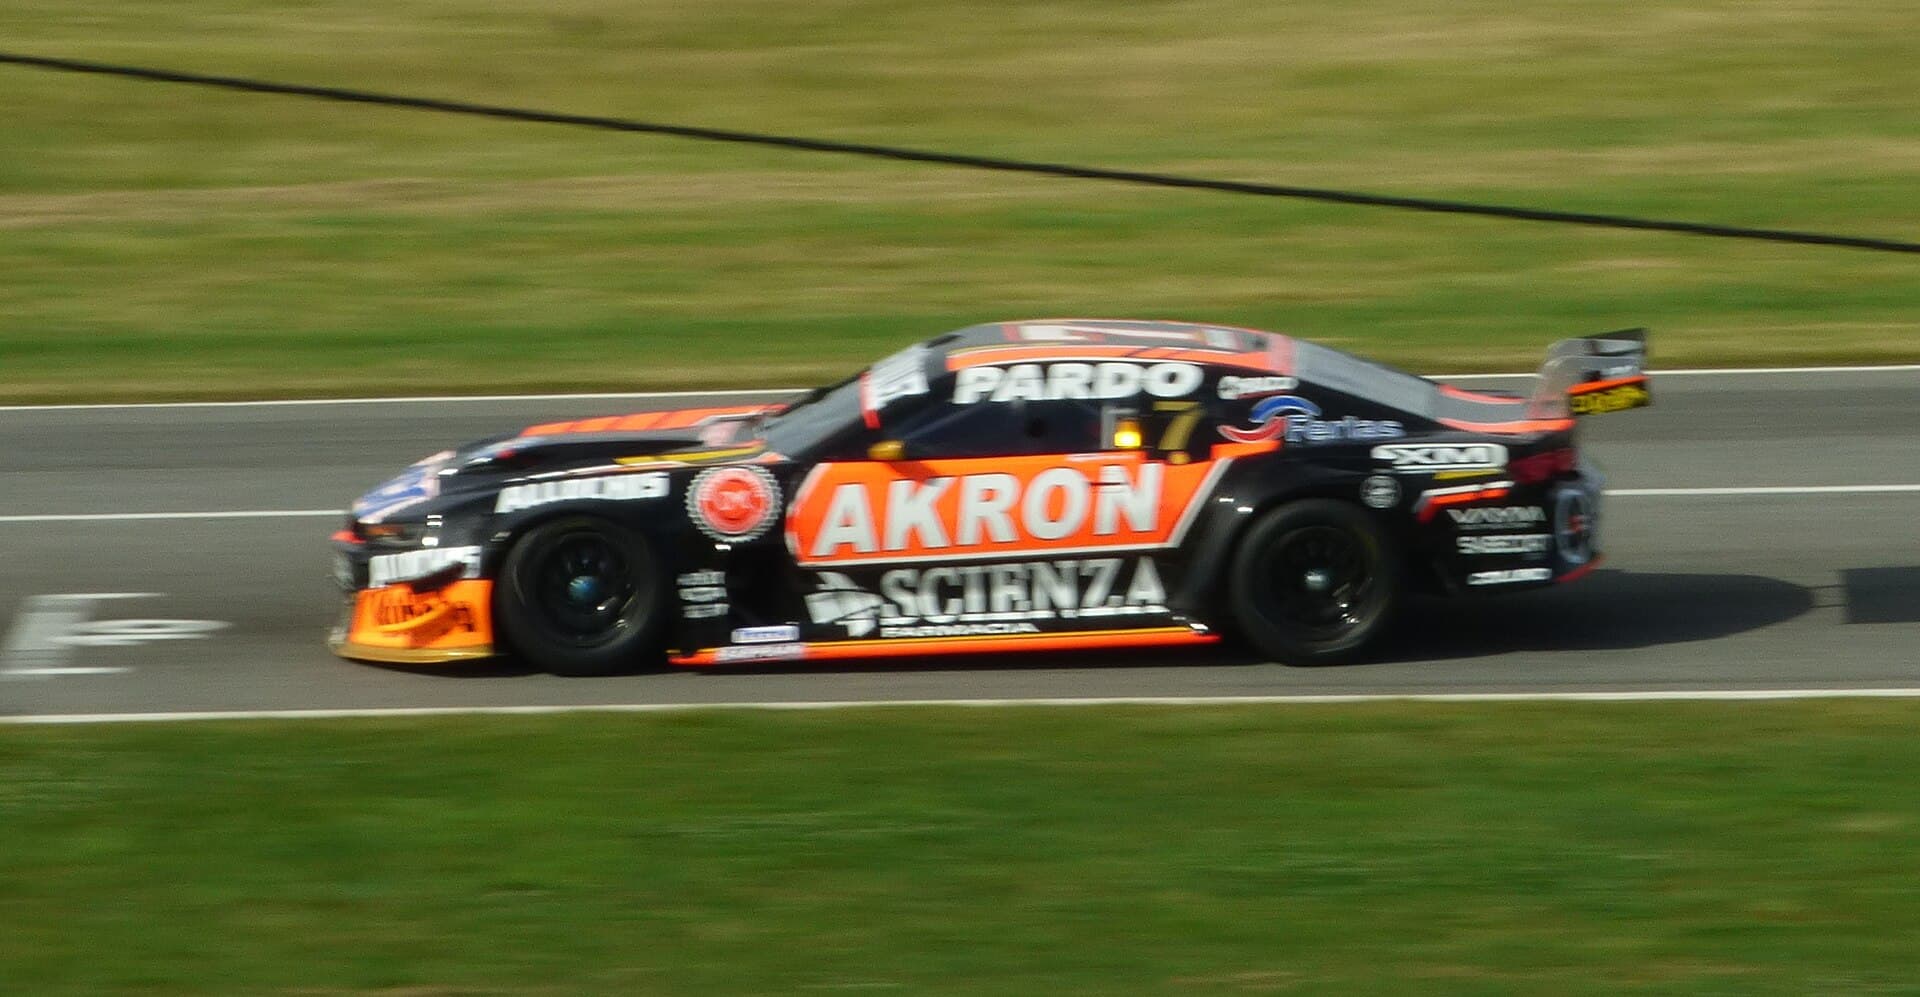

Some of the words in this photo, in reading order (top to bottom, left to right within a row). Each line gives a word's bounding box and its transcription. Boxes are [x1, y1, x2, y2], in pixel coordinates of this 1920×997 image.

[952, 361, 1204, 404] PARDO
[1152, 400, 1206, 450] 7
[810, 462, 1164, 557] AKRON
[879, 557, 1170, 626] SCIENZA
